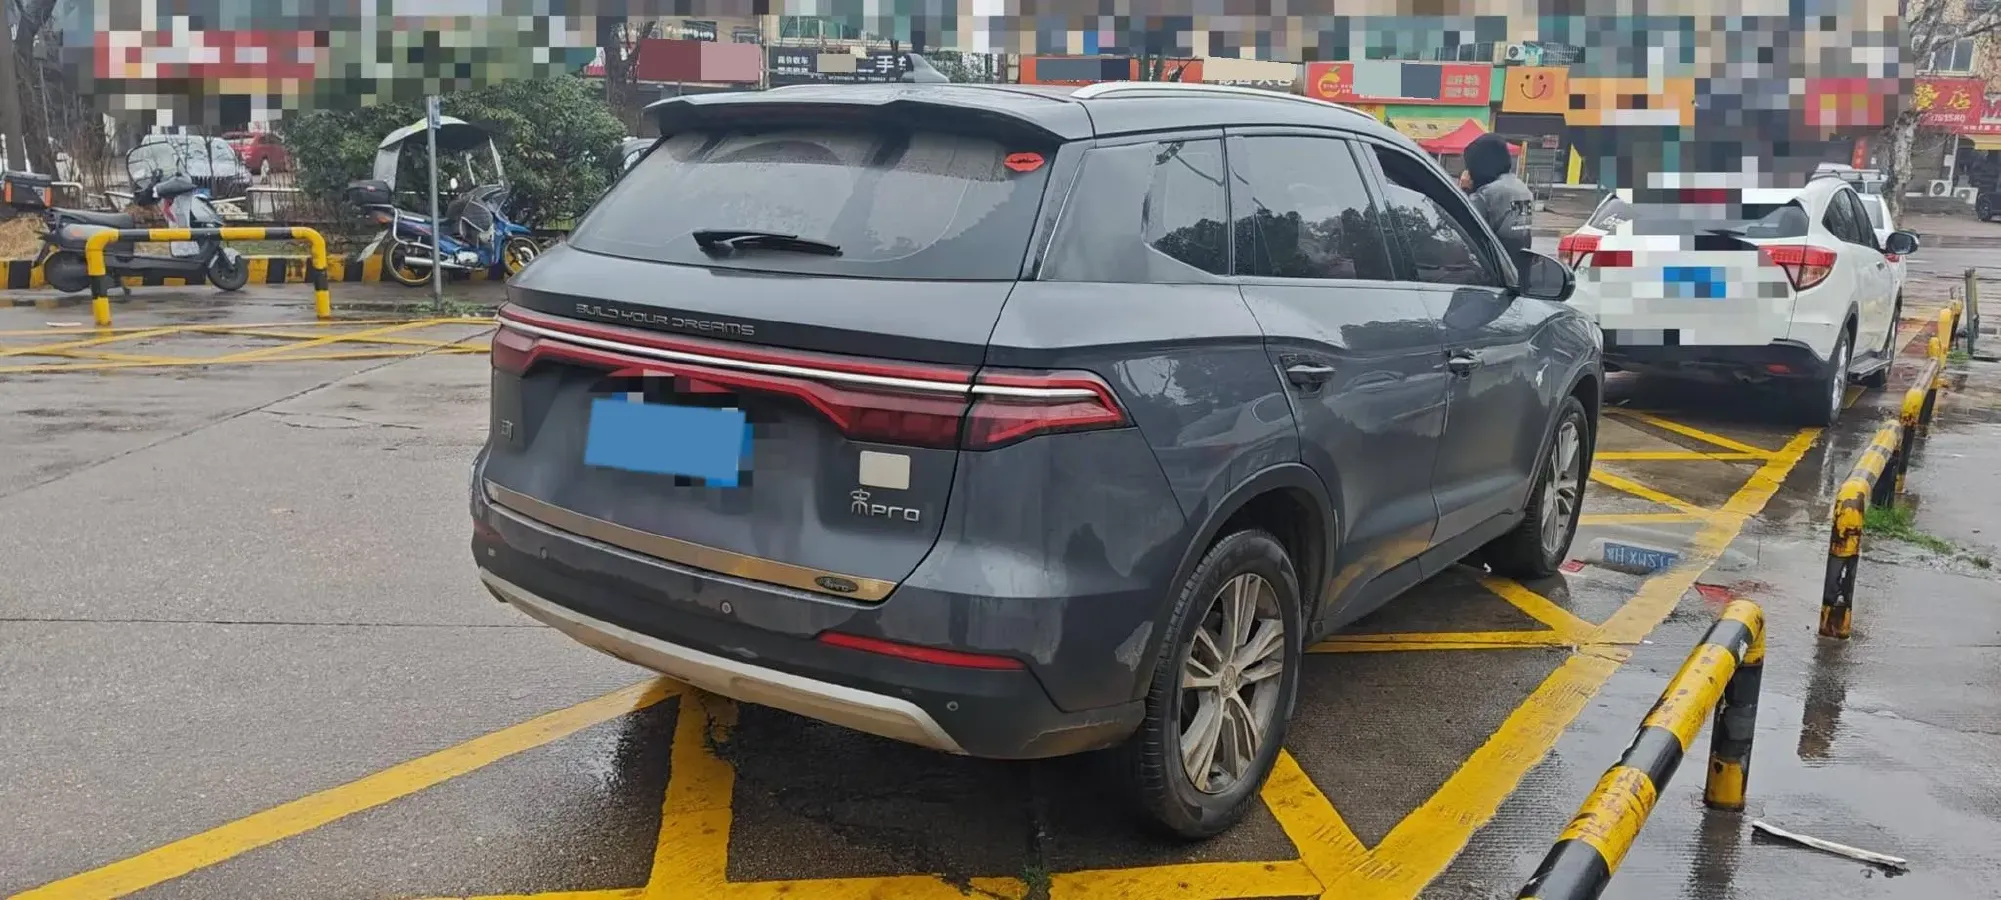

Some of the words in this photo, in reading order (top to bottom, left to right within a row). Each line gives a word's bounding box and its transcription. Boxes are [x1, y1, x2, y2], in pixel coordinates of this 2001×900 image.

[575, 302, 619, 319] BUILD
[621, 310, 669, 325] YOUR
[671, 317, 755, 336] DREAMS
